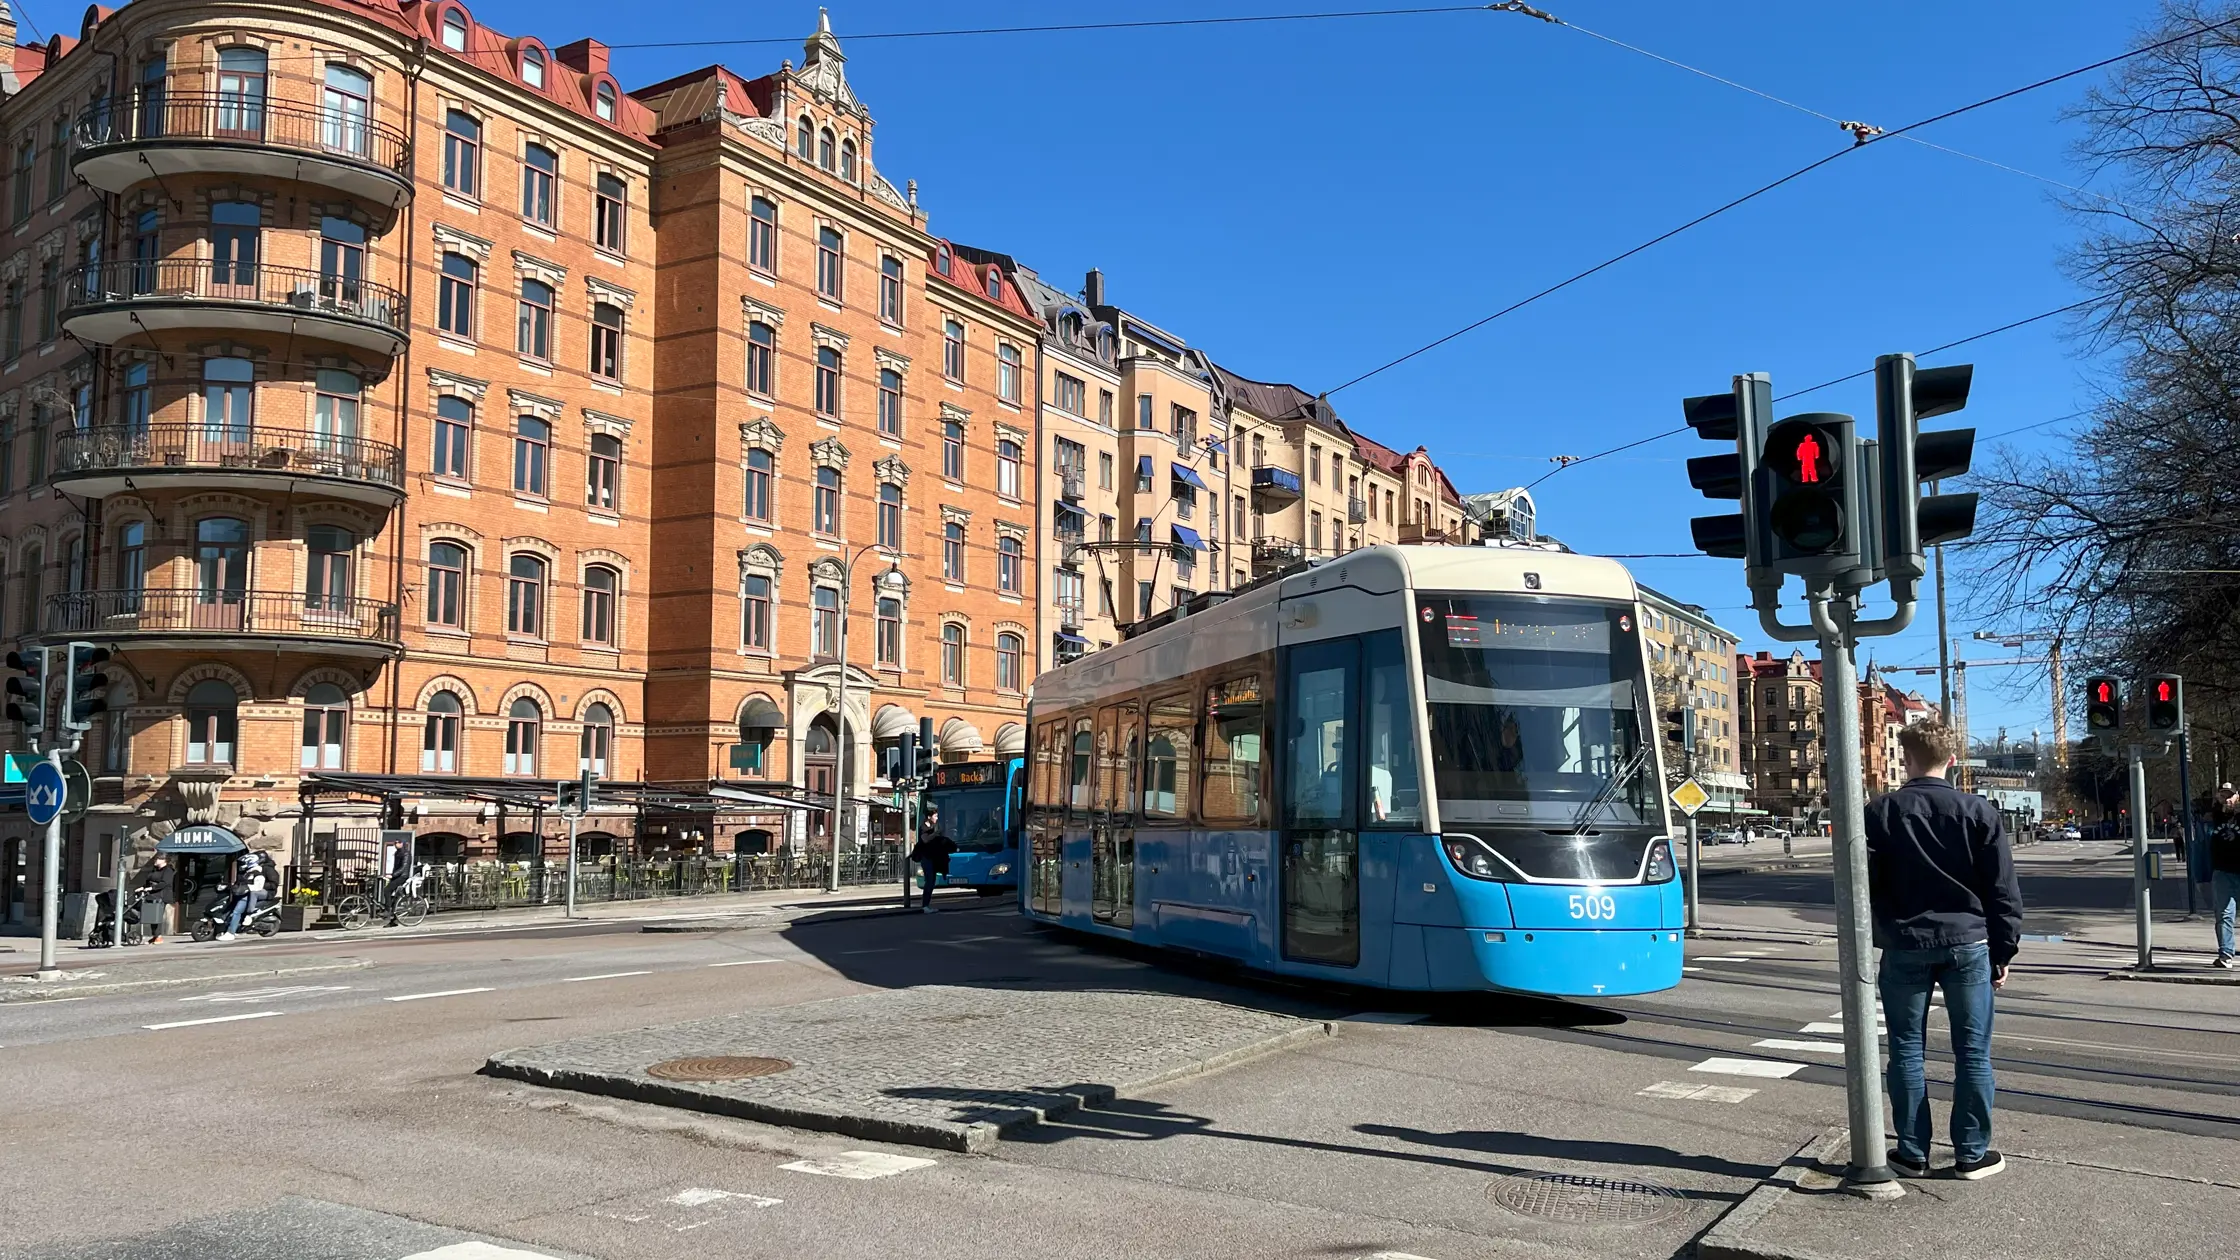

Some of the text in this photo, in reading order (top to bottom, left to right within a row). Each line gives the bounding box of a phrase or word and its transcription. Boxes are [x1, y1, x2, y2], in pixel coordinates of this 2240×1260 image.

[936, 771, 984, 785] 18 Backa
[174, 831, 217, 844] HUMM.
[1569, 894, 1616, 920] 509
